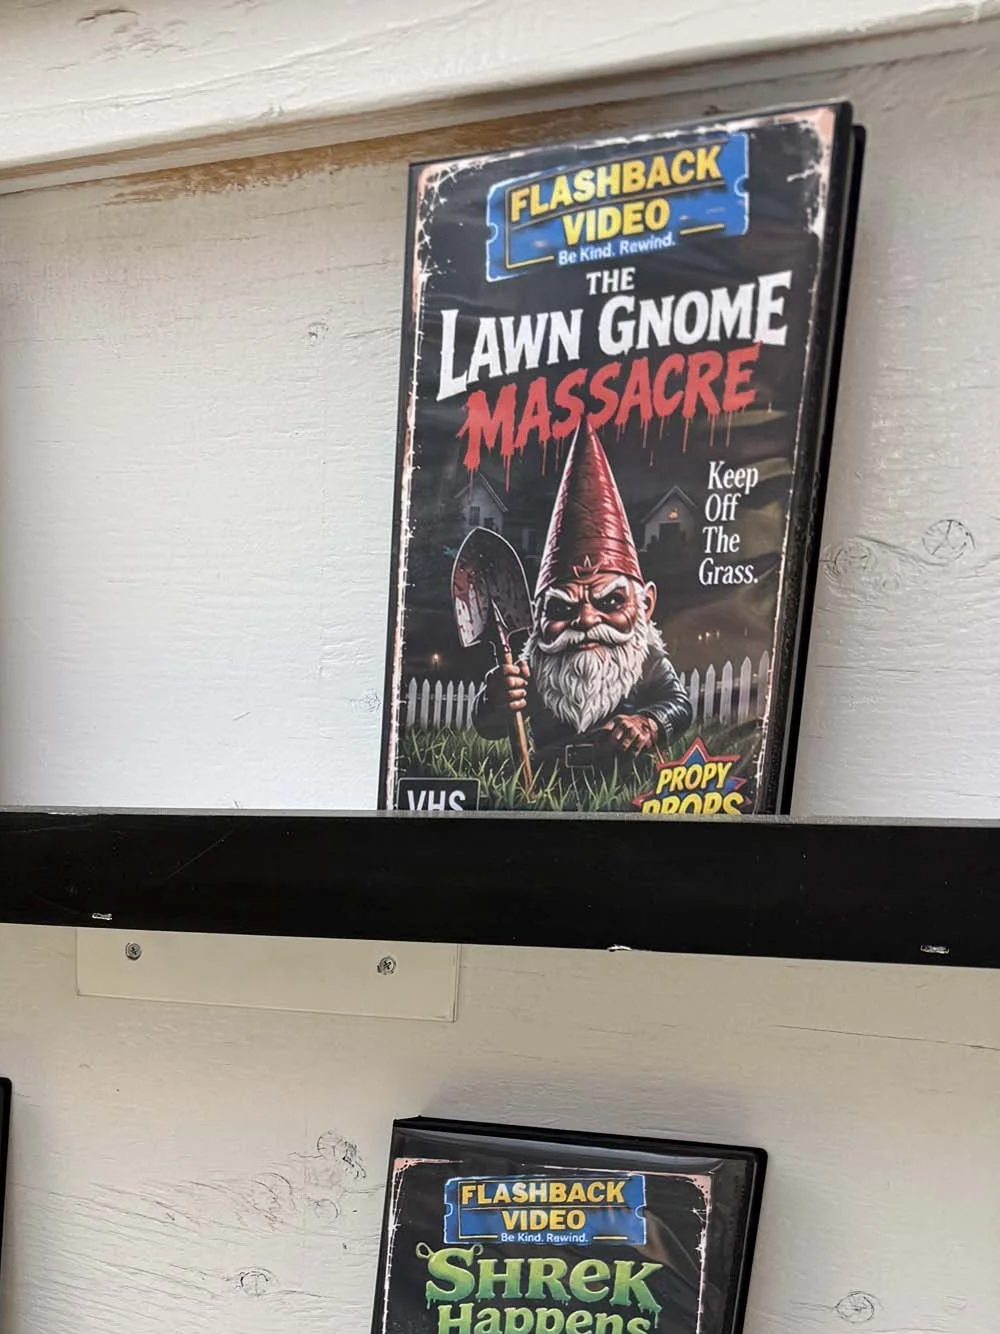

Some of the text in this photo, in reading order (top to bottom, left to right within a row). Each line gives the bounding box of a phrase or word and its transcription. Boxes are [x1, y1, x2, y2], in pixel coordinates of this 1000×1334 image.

[510, 143, 721, 223] FLASHBACK
[562, 198, 670, 246] VIDEO
[558, 232, 676, 266] Be Kind. Rewind.
[586, 267, 636, 295] THE
[437, 271, 792, 402] LAWN GNOME
[456, 340, 764, 473] MASSACRE
[707, 460, 759, 490] Keep
[704, 494, 741, 522] Off
[703, 526, 740, 553] The
[699, 559, 759, 585] Grass.
[655, 761, 732, 794] PROPY
[461, 1181, 625, 1205] FLASHBACK
[502, 1210, 586, 1230] VIDEO
[501, 1232, 588, 1243] Be Kind. Rewind.
